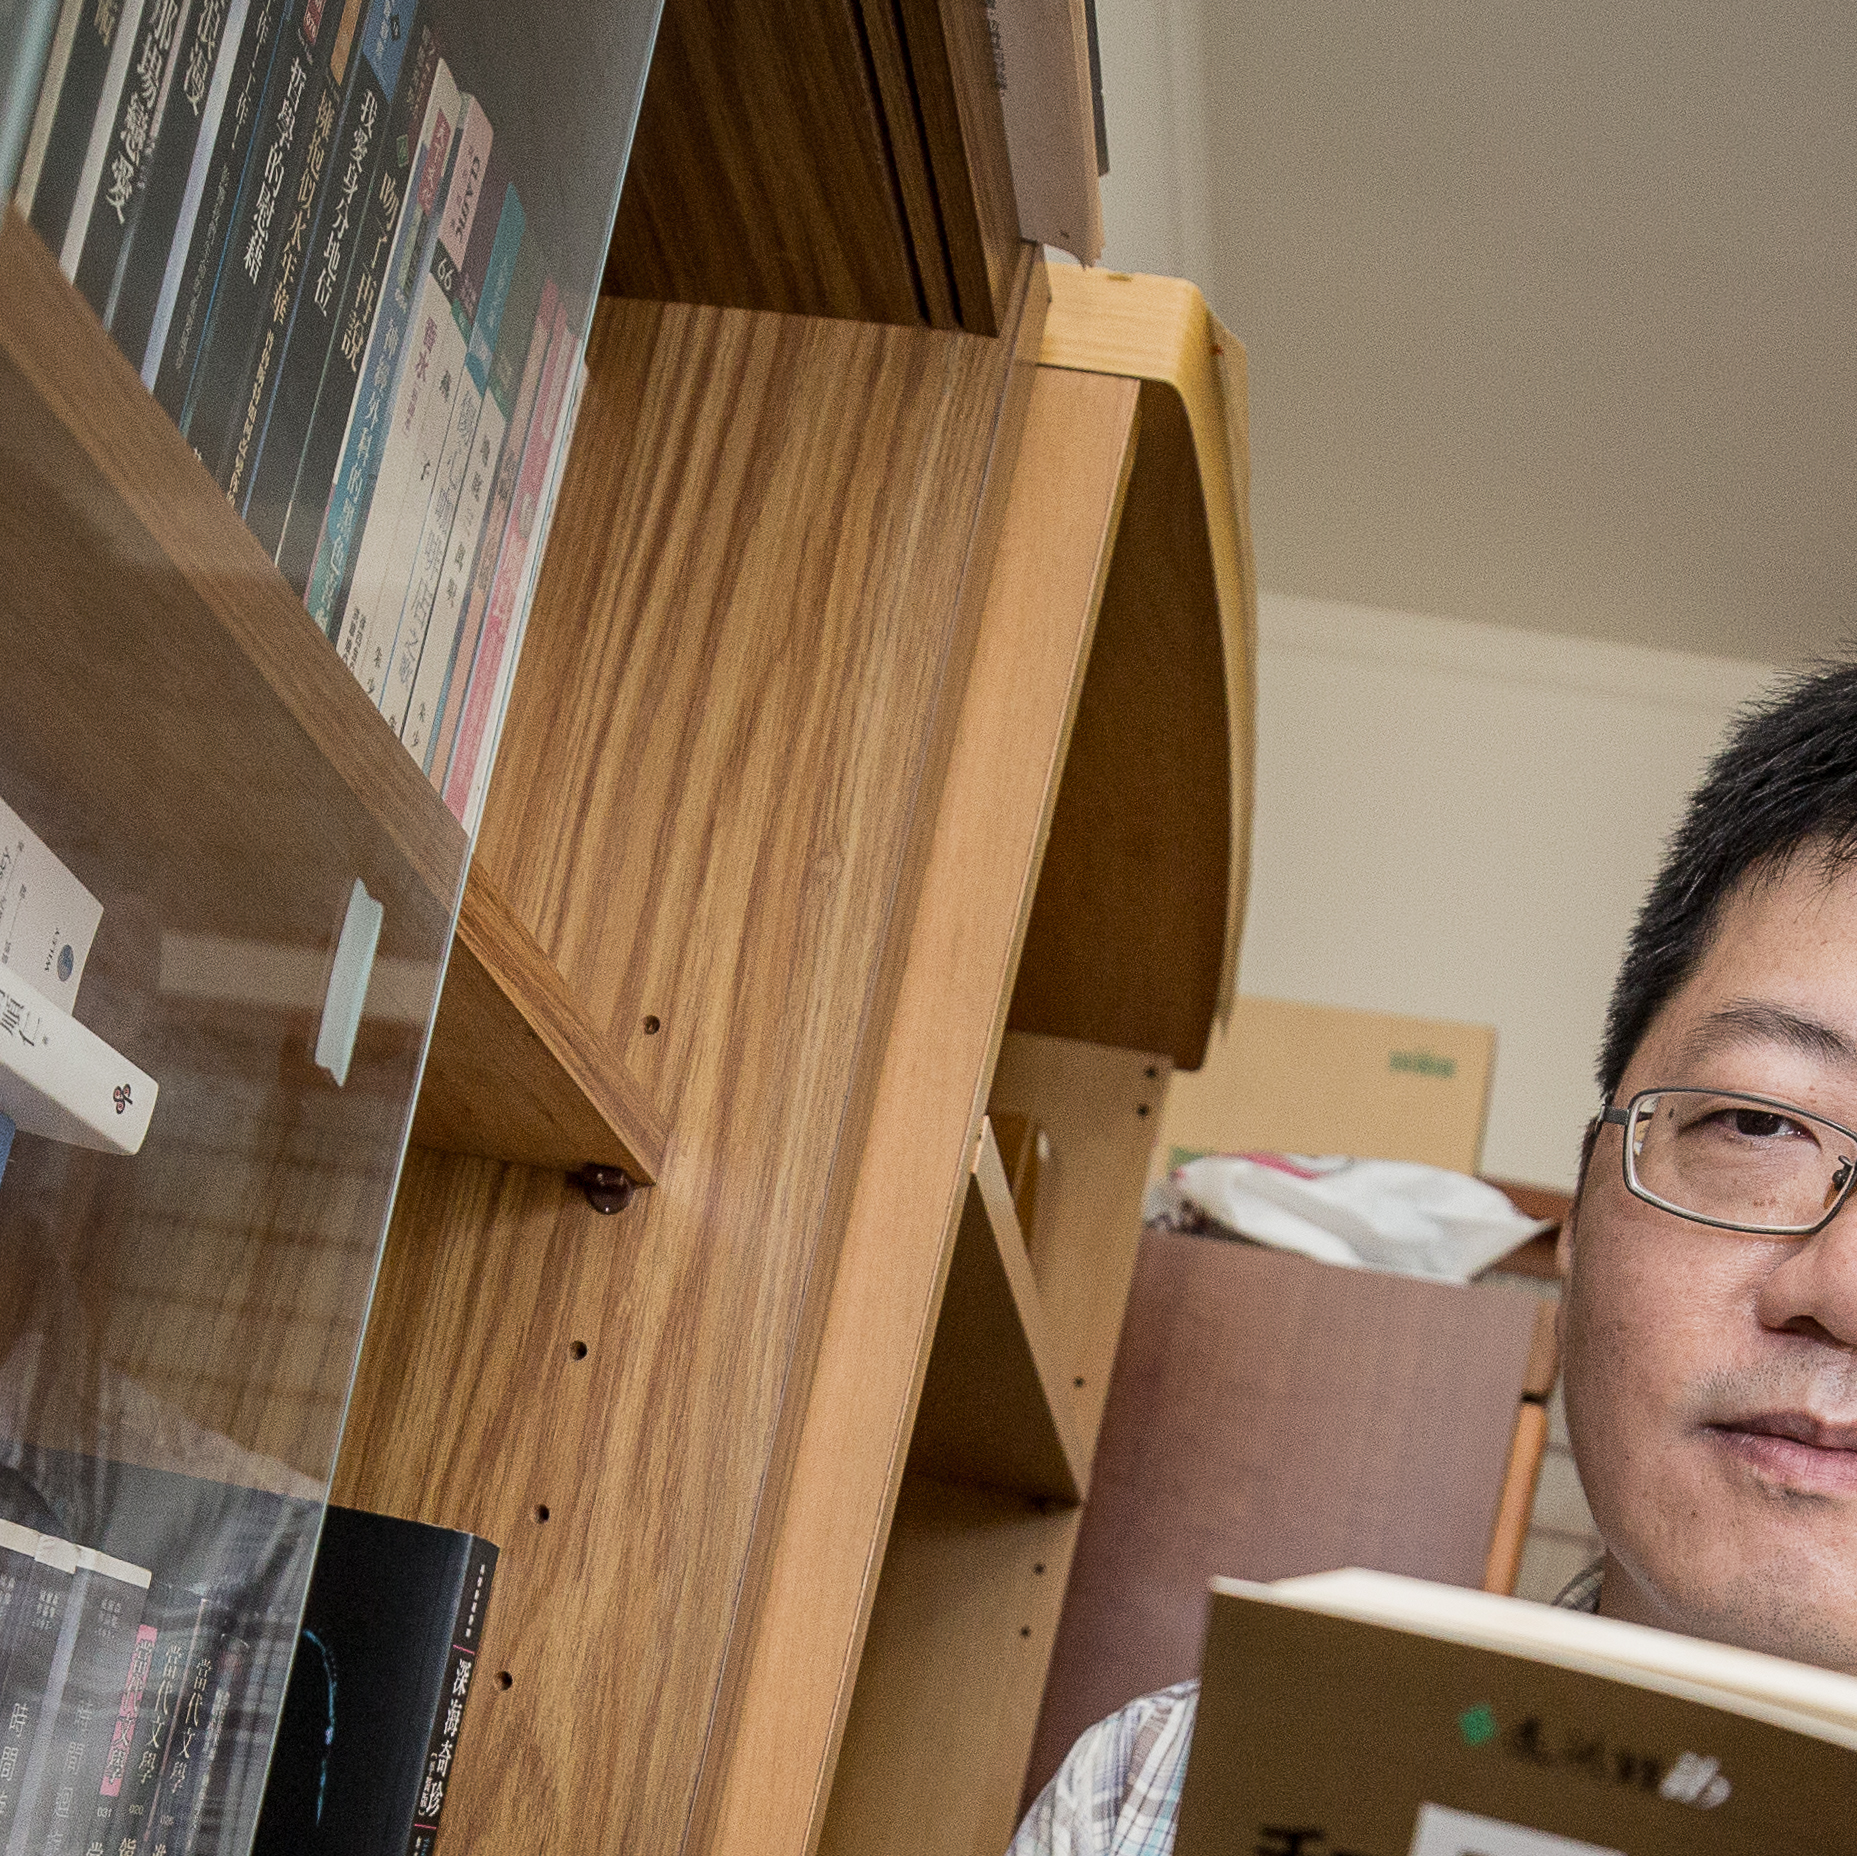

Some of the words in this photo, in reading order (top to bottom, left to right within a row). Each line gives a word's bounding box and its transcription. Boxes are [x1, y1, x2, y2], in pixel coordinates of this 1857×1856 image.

[238, 52, 311, 286] 哲學的慰藉
[266, 89, 339, 329] 擁抱似水年華
[310, 84, 381, 318] 我愛身分地位
[337, 171, 403, 374] 吻了再說
[413, 315, 439, 384] 香水
[433, 253, 457, 293] 66
[103, 1637, 154, 1785] 當代文學
[135, 1644, 183, 1785] 當代文學
[166, 1656, 214, 1795] 當代文學
[424, 1658, 472, 1819] 深海奇珍
